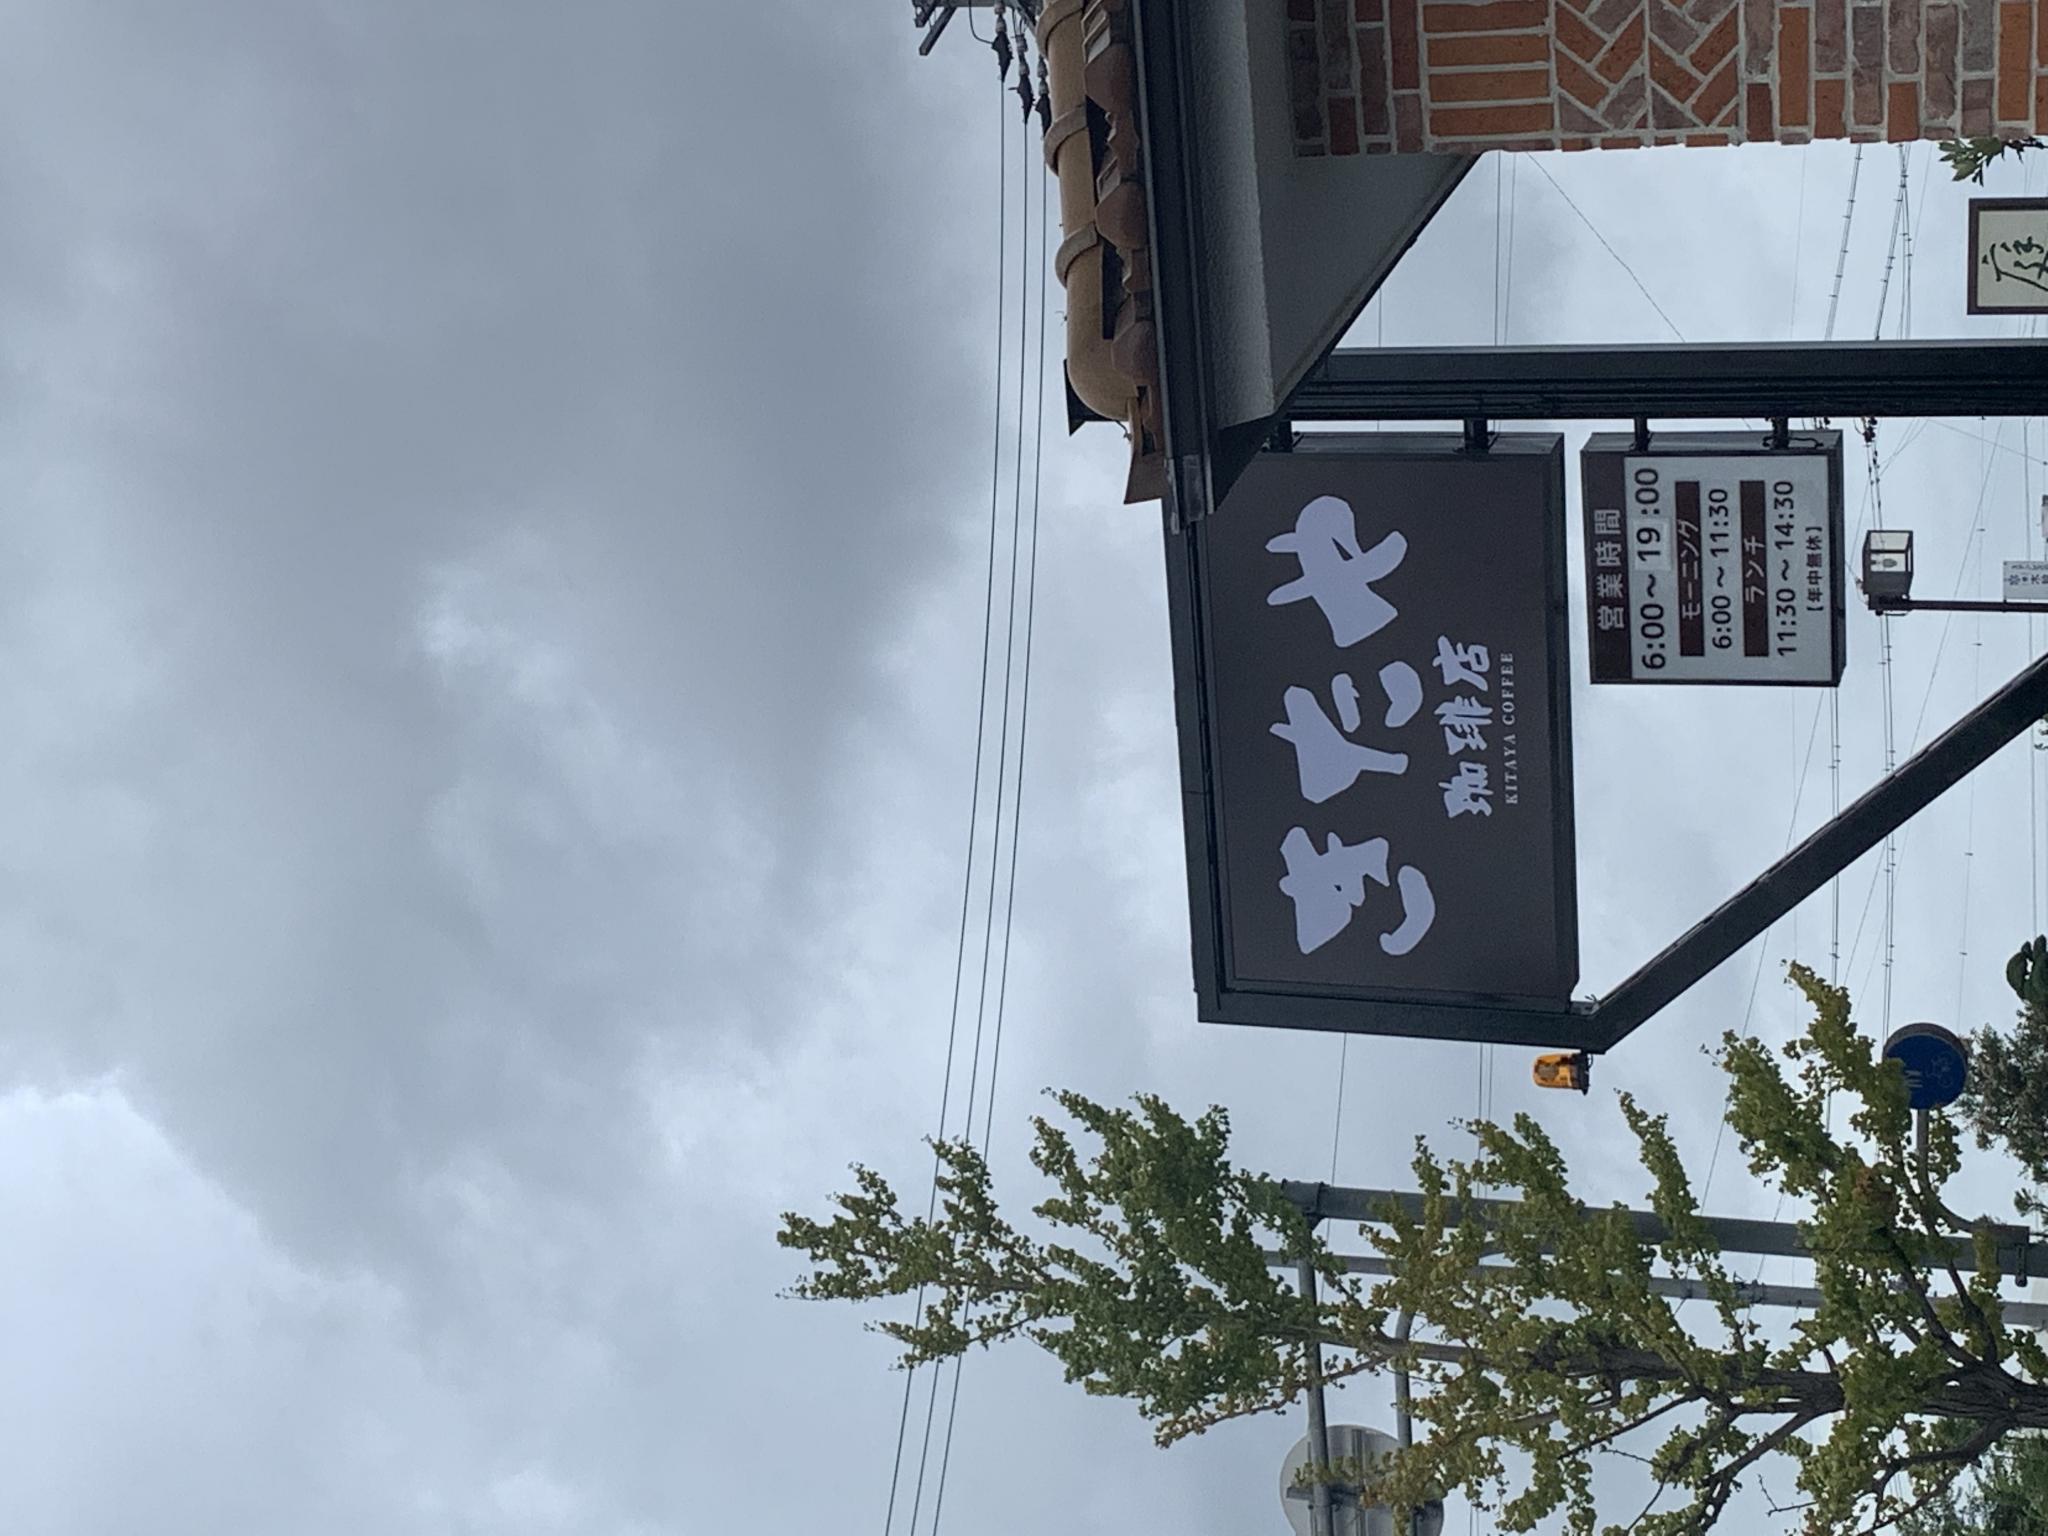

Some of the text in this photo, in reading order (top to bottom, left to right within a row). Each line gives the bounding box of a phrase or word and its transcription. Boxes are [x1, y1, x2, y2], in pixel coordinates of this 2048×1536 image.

[1594, 509, 1624, 630] 営業時間
[1677, 518, 1701, 621] モーニング
[1743, 535, 1766, 604] ランチ
[1265, 495, 1436, 956] きたや
[1432, 635, 1494, 818] 珈琲店
[1500, 653, 1518, 804] KITAYA COFFEE
